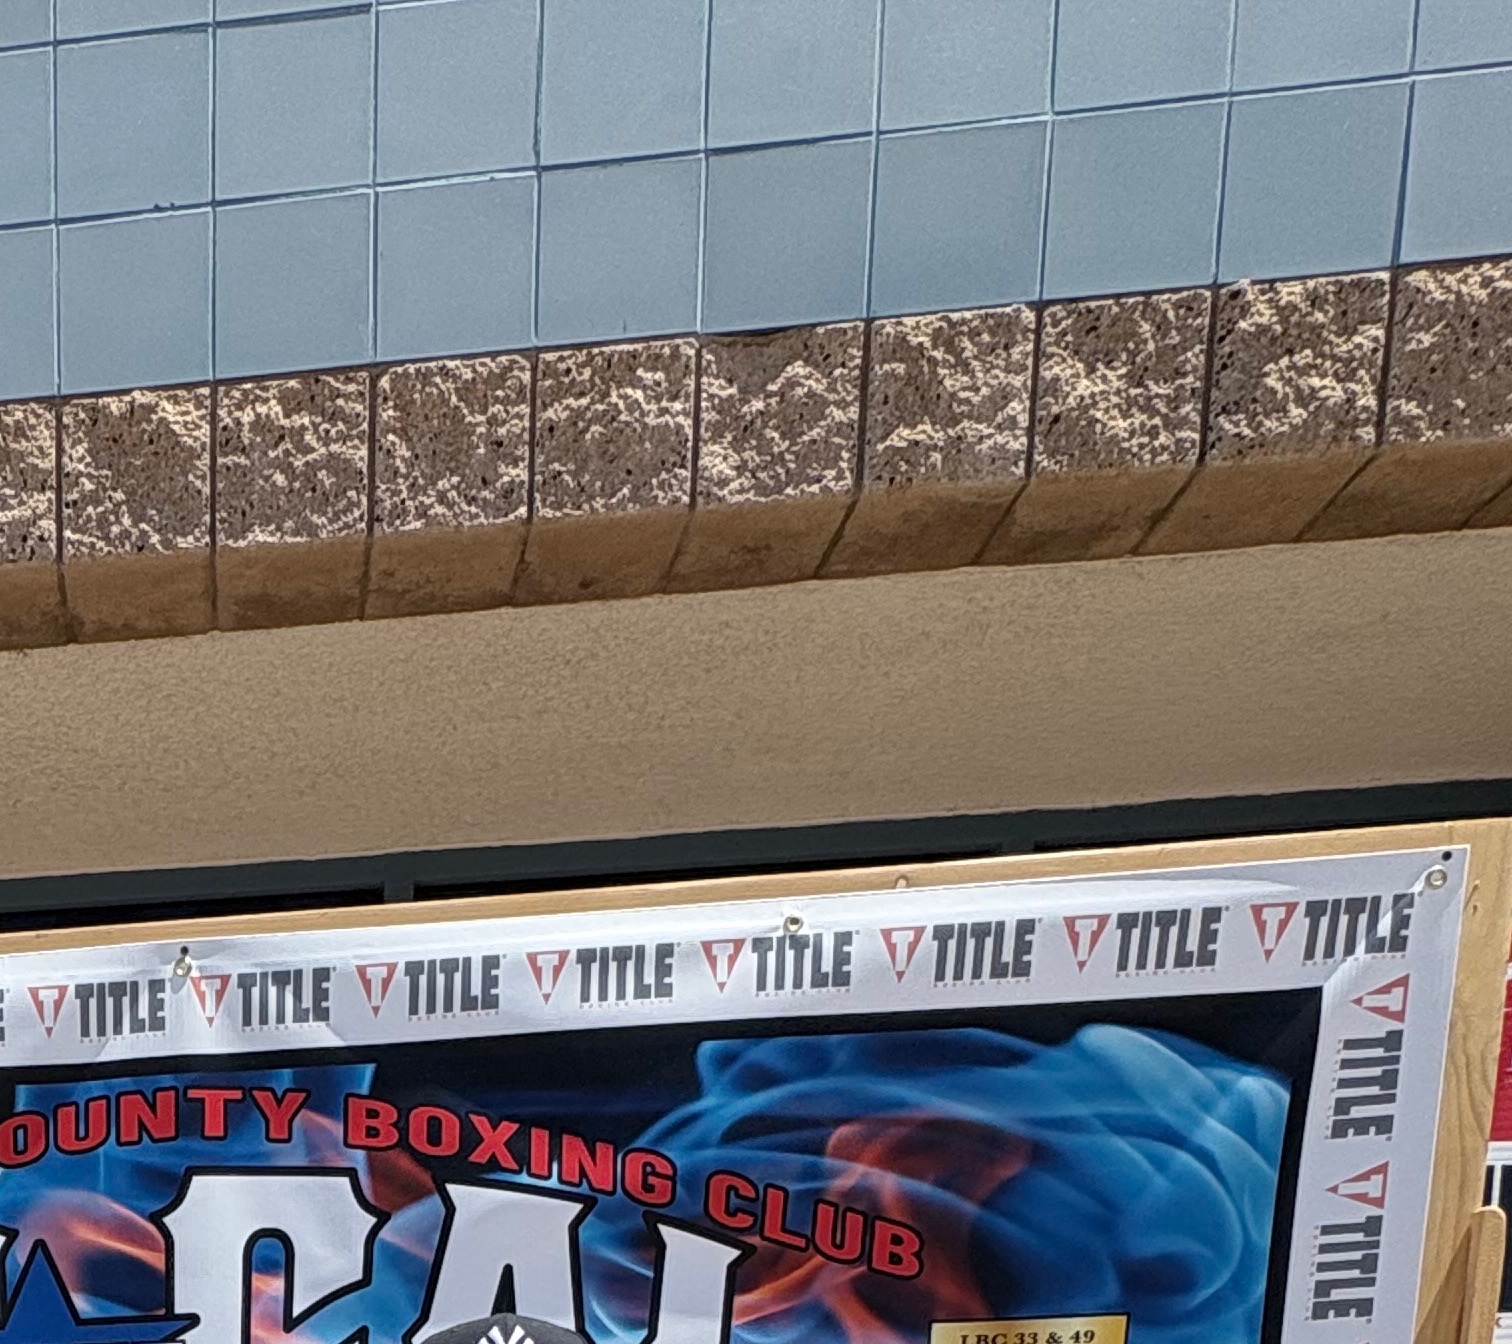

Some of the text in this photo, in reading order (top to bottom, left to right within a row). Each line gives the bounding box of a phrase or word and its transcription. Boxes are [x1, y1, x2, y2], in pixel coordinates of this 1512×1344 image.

[932, 918, 1036, 982] TITLE
[1116, 907, 1222, 972] TITLE
[1302, 893, 1414, 962] TITLE
[404, 955, 500, 1017] TITLE
[576, 943, 674, 1003] TITLE
[751, 931, 853, 992] TITLE
[75, 979, 166, 1037] TITLE
[237, 967, 330, 1027] TITLE
[1331, 1029, 1403, 1140] TITLE
[346, 1096, 676, 1206] BOXING
[706, 1171, 923, 1280] CLUB
[1311, 1215, 1383, 1321] TITLE
[1069, 1330, 1096, 1344] 49
